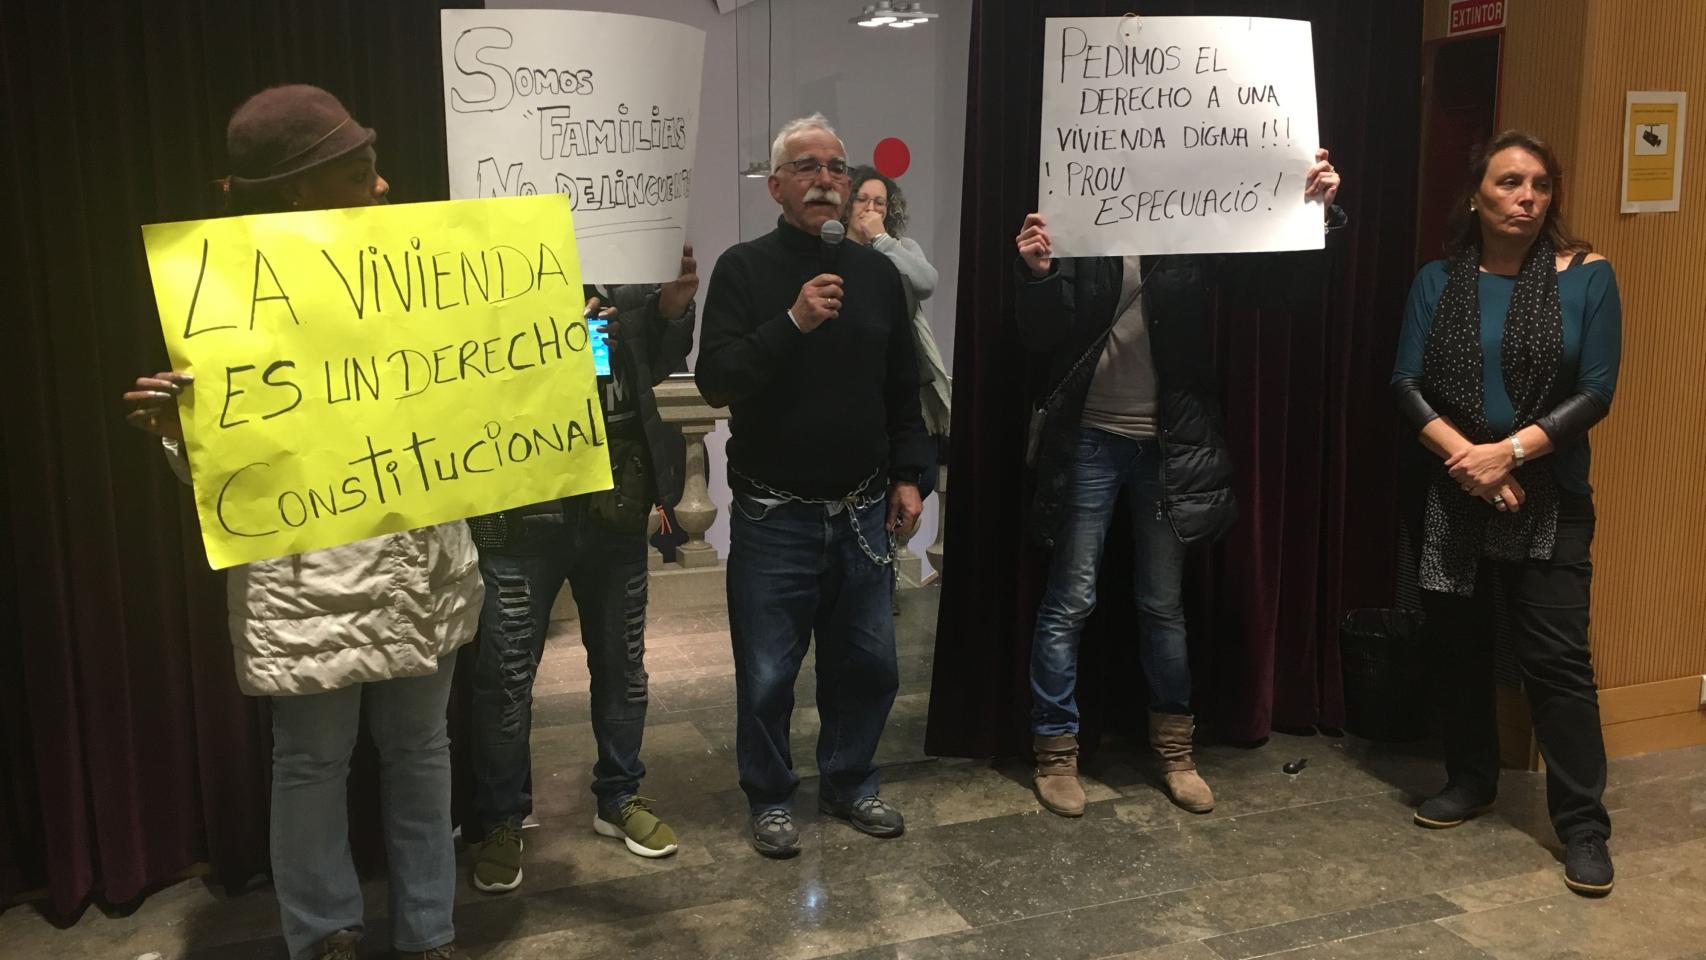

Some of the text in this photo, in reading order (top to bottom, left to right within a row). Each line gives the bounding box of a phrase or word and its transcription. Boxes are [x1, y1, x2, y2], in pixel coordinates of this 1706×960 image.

[1452, 2, 1502, 28] EXTINTOR
[1060, 26, 1228, 83] PEDIMOS EL
[1080, 84, 1280, 116] DERECHO A UNA
[1067, 161, 1126, 196] PROU
[183, 238, 300, 340] LA
[219, 316, 589, 429] ES UN DERECHO
